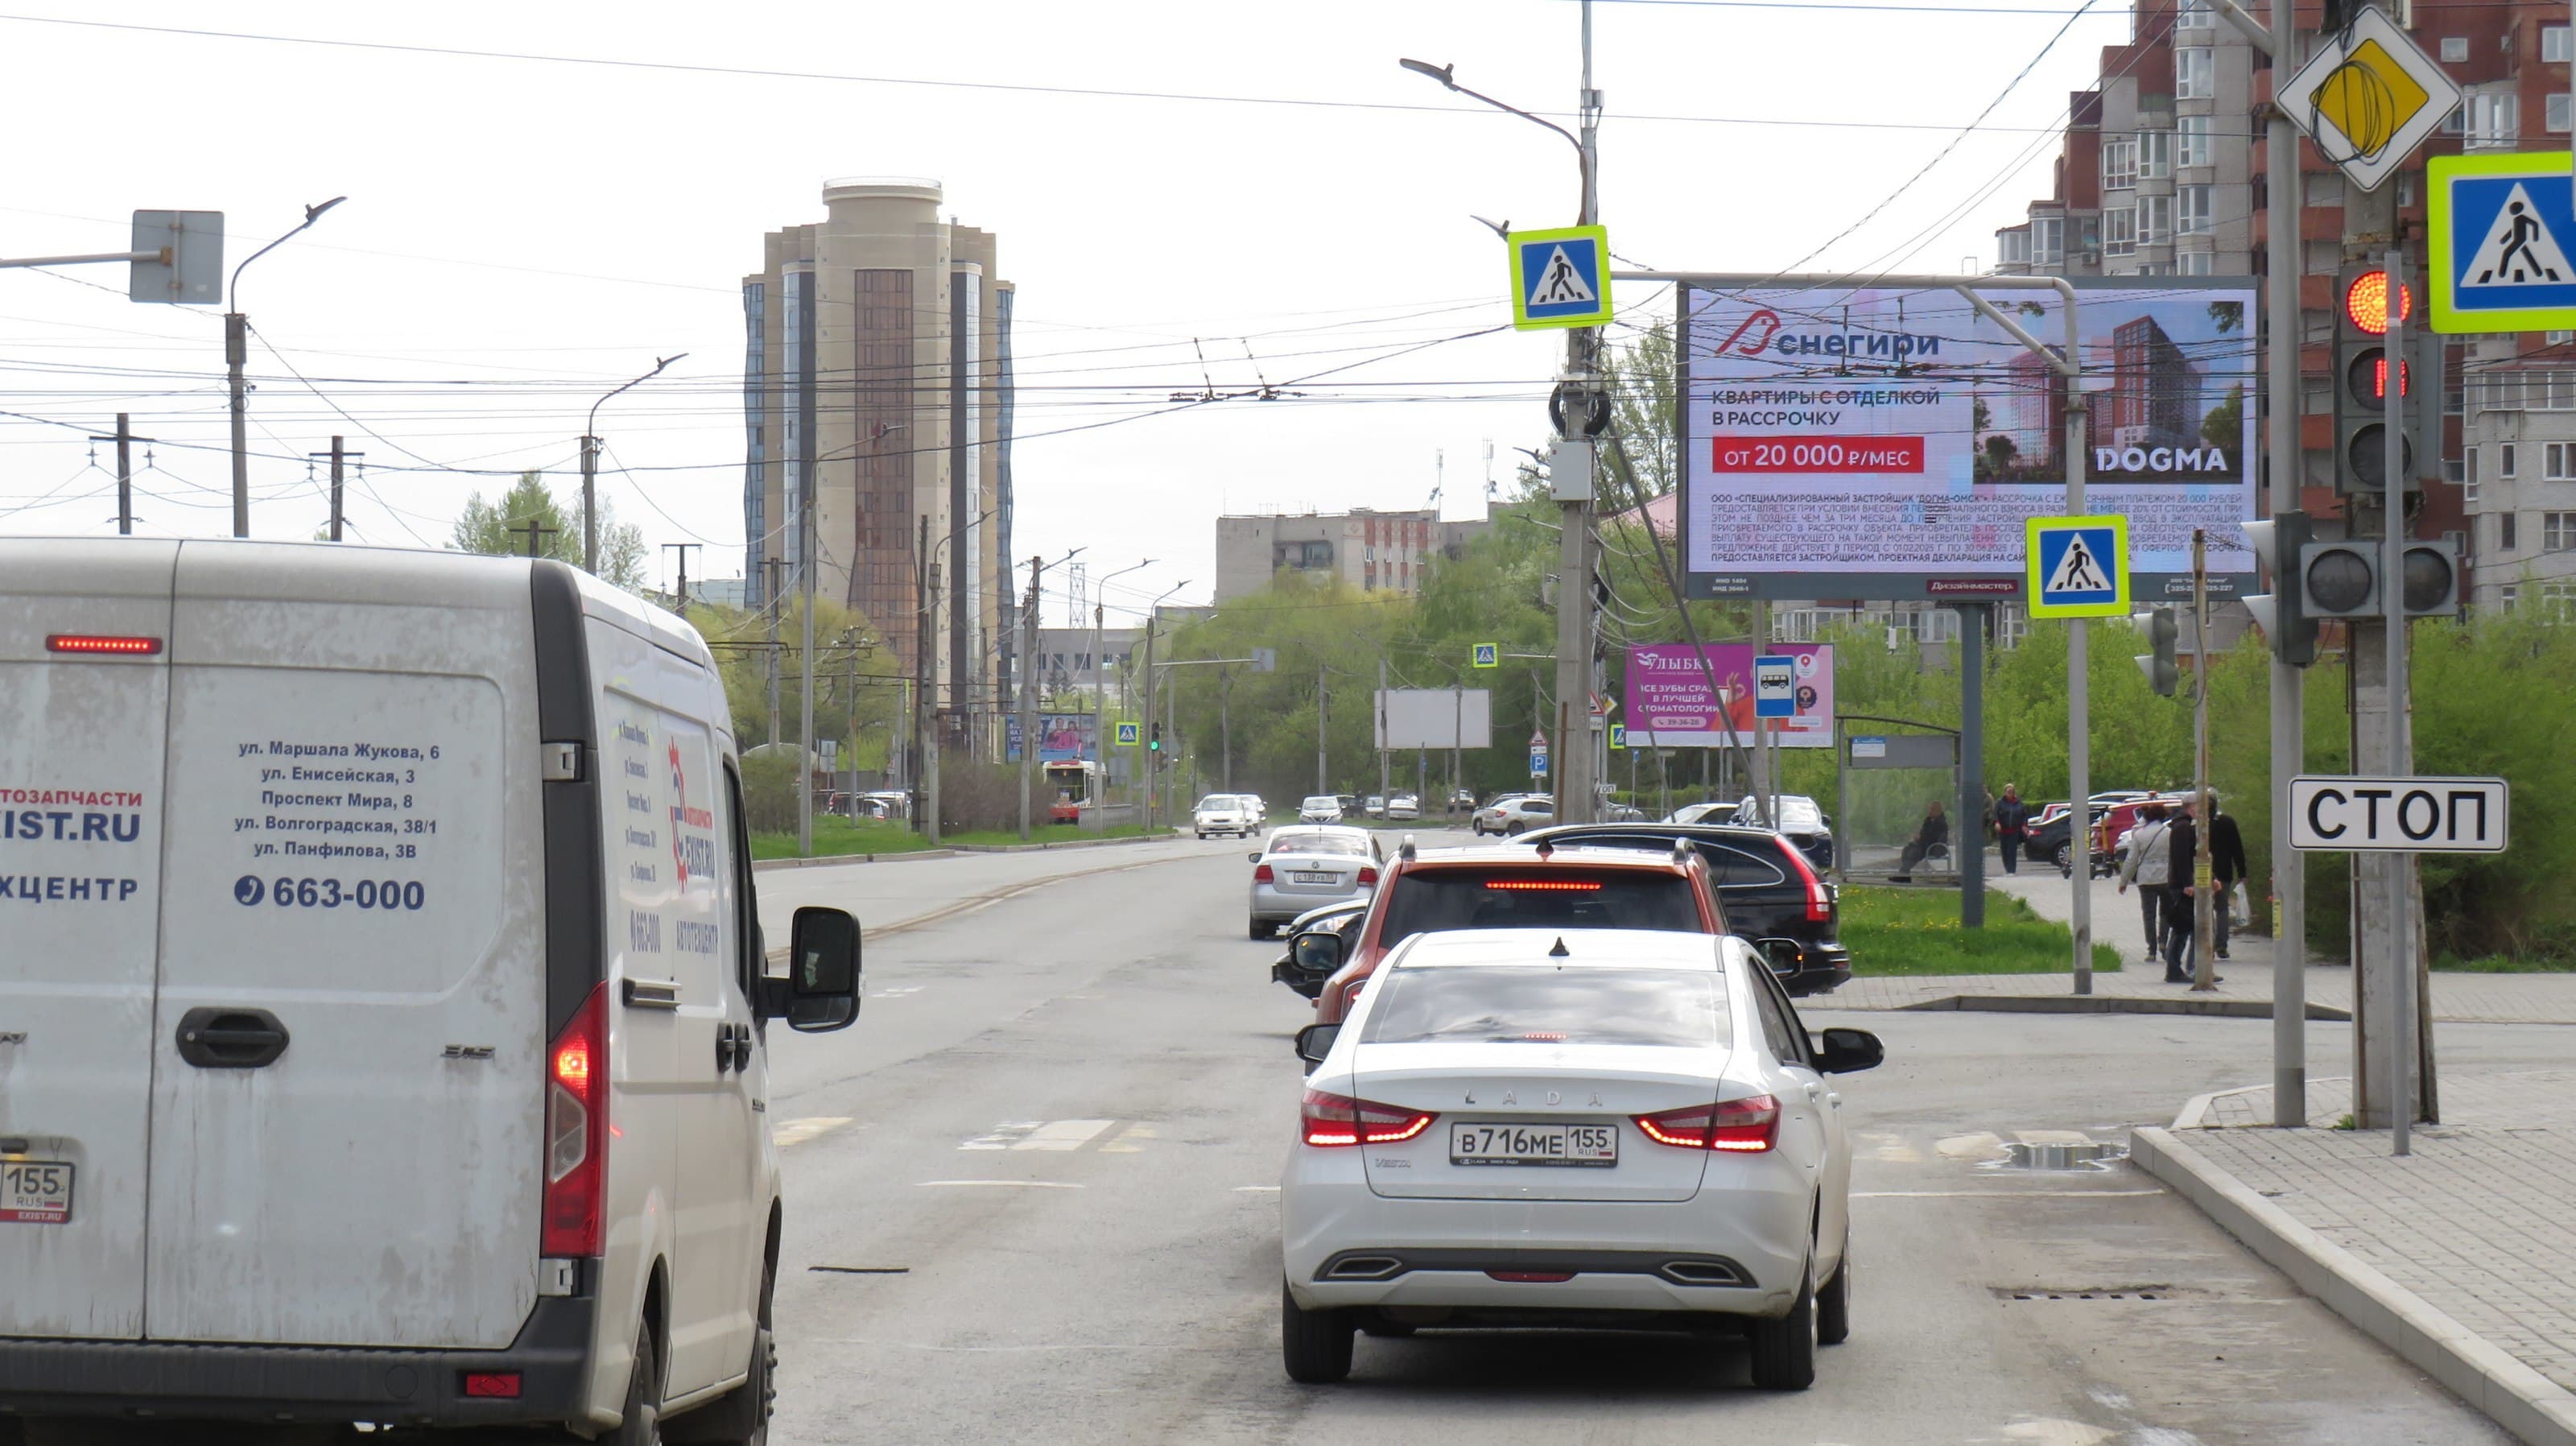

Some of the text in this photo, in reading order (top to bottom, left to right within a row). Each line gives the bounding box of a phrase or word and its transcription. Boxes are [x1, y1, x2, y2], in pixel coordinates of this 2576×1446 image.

[1777, 334, 1939, 361] снегири
[1712, 386, 1939, 407] КВАРТИРЫ С ОТДЕЛКОЙ
[1712, 411, 1840, 426] В РАССРОЧКУ
[1724, 451, 1750, 465] ОТ
[1755, 444, 1785, 465] 20
[1793, 444, 1843, 465] 000
[2095, 448, 2228, 472] DOGMA
[1711, 494, 1732, 502] ООО
[1852, 493, 1913, 504] ЗАСТРОЙЩИК
[1992, 494, 2043, 502] РАССРОЧКА
[2046, 494, 2051, 502] С
[2054, 494, 2124, 502] ЕЖСЯЧНЫМ
[2126, 494, 2174, 502] ПЛАТЕЖОМ
[2177, 494, 2188, 502] 20
[2190, 494, 2206, 502] 000
[2209, 493, 2242, 502] РУБЛЕЙ
[1711, 505, 1795, 514] ПРЕДОСТАВЛЯЕТСЯ
[1711, 514, 1736, 523] ЭТОМ
[1740, 514, 1752, 523] НЕ
[1757, 514, 1797, 523] ПОЗДНЕЕ
[1802, 514, 1820, 523] ЧЕМ
[1825, 514, 1835, 523] ЗА
[1840, 514, 1856, 523] ТРИ
[1860, 514, 1897, 523] МЕСЯЦА
[1901, 514, 1913, 523] ДО
[1918, 514, 1971, 523] ПУЧЕНИЯ
[2133, 514, 2157, 523] ВВОД
[2161, 514, 2166, 523] В
[2170, 514, 2242, 523] ЭКСПЛУАТАЦИЮ
[1711, 524, 1793, 532] ПРИОБРЕТАЕМОГО
[1798, 524, 1803, 532] В
[1809, 524, 1858, 532] РАССРОЧКУ
[1909, 524, 1980, 532] ПРИОБРЕТАТЕЛЬ
[2141, 524, 2197, 532] ОБЕСПЕЧИТЬ
[1711, 534, 1751, 542] ВЫПЛАТУ
[1755, 534, 1835, 543] СУЩЕСТВУЮЩЕГО
[1839, 534, 1851, 542] НА
[1855, 533, 1882, 542] ТАКОЙ
[1887, 534, 1924, 542] МОМЕНТ
[1928, 534, 2011, 542] НЕВЫПЛАЧЕННОГО
[1711, 543, 1777, 552] ПРЕДЛОЖЕНИЕ
[1781, 543, 1831, 552] ДЕЙСТВУЕТ
[1835, 543, 1840, 552] В
[1843, 543, 1880, 552] ПЕРИОД
[1883, 543, 1891, 552] С
[1948, 543, 1961, 552] ПО
[2190, 543, 2242, 552] РСРОЧКА
[1711, 554, 1797, 563] ПРЕДОСТАВЛЯЕТСЯ
[1878, 554, 1930, 562] ПРОЕКТНАЯ
[1932, 554, 1991, 563] ДЕКЛАРАЦИЯ
[1994, 554, 2004, 562] НА
[1659, 684, 1686, 692] ЗУБЫ
[1653, 693, 1706, 703] В ЛУЧШЕЙ
[238, 741, 440, 762] ул. Маршала Жукова, 6
[261, 766, 415, 785] ул. Енисейская, 3
[262, 791, 413, 811] Проспект Мира, 8
[2307, 788, 2486, 841] СТОП
[0, 810, 140, 842] IST.RU
[234, 816, 436, 834] ул. Волгоградская, 38/1
[254, 841, 416, 860] ул. Панфилова, 3В
[274, 877, 425, 910] 663-000
[1465, 1089, 1603, 1106] LADA
[1462, 1129, 1608, 1155] В716МЕ 155
[1578, 1148, 1598, 1156] RUS
[6, 1167, 60, 1195] 155
[16, 1196, 43, 1208] RUS
[19, 1211, 62, 1221] EXIST.RU
